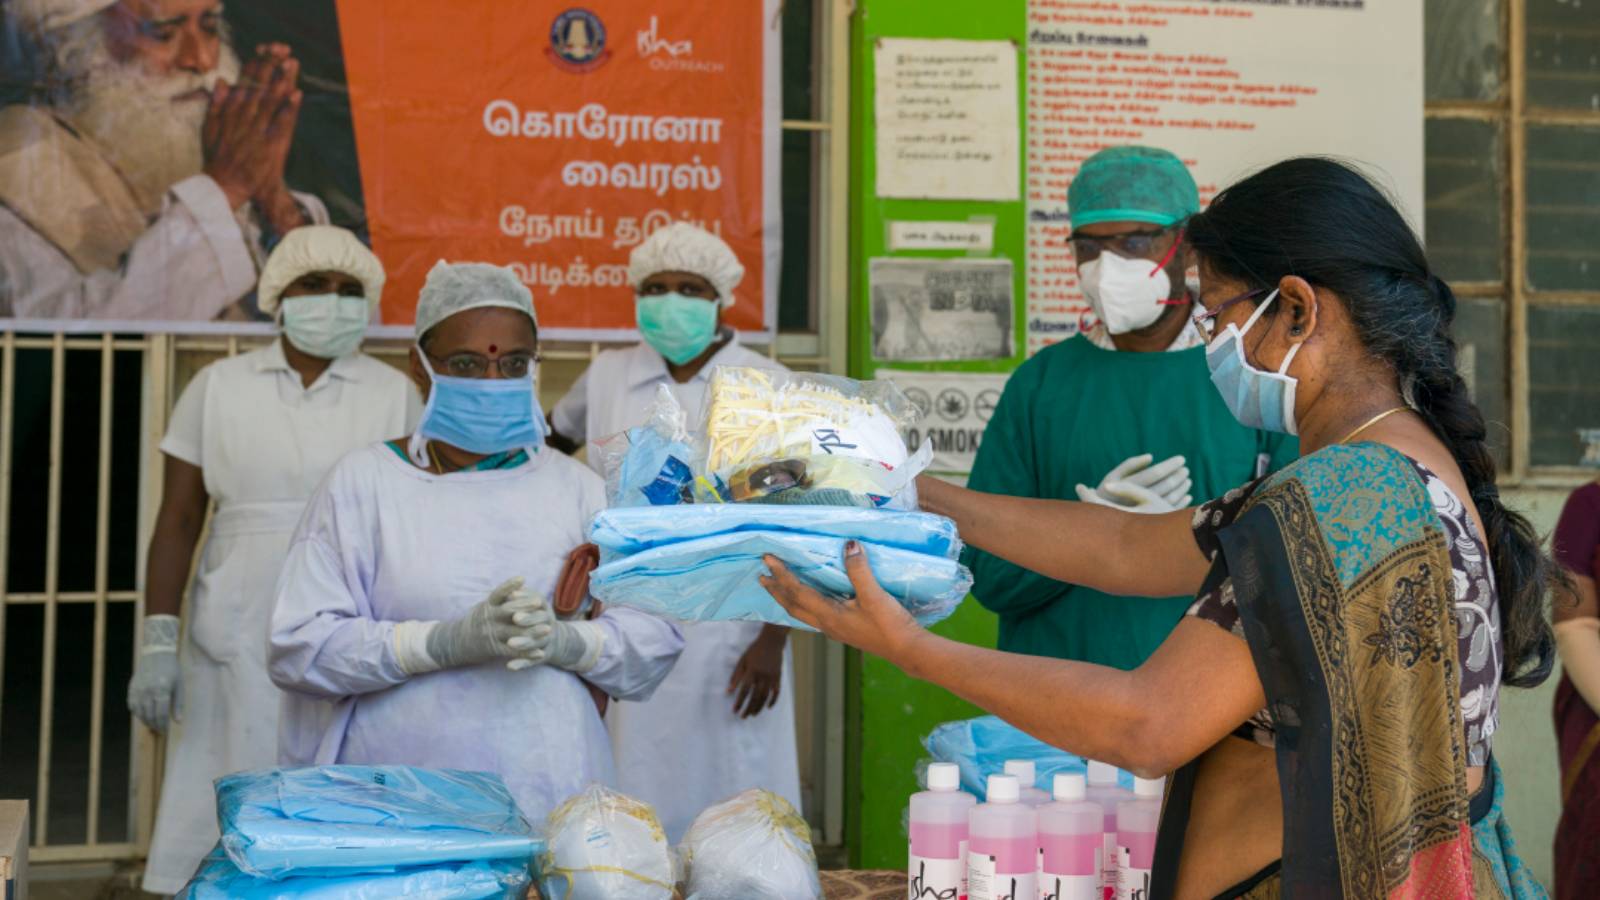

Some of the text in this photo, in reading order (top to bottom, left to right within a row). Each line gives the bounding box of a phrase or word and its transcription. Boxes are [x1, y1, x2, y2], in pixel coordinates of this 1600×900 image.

[637, 15, 692, 57] isha
[649, 58, 724, 72] OUTREACH
[483, 99, 722, 147] கொரோனா
[562, 156, 721, 196] வைரஸ்
[499, 205, 604, 248] நோய்
[927, 427, 979, 453] SMOK
